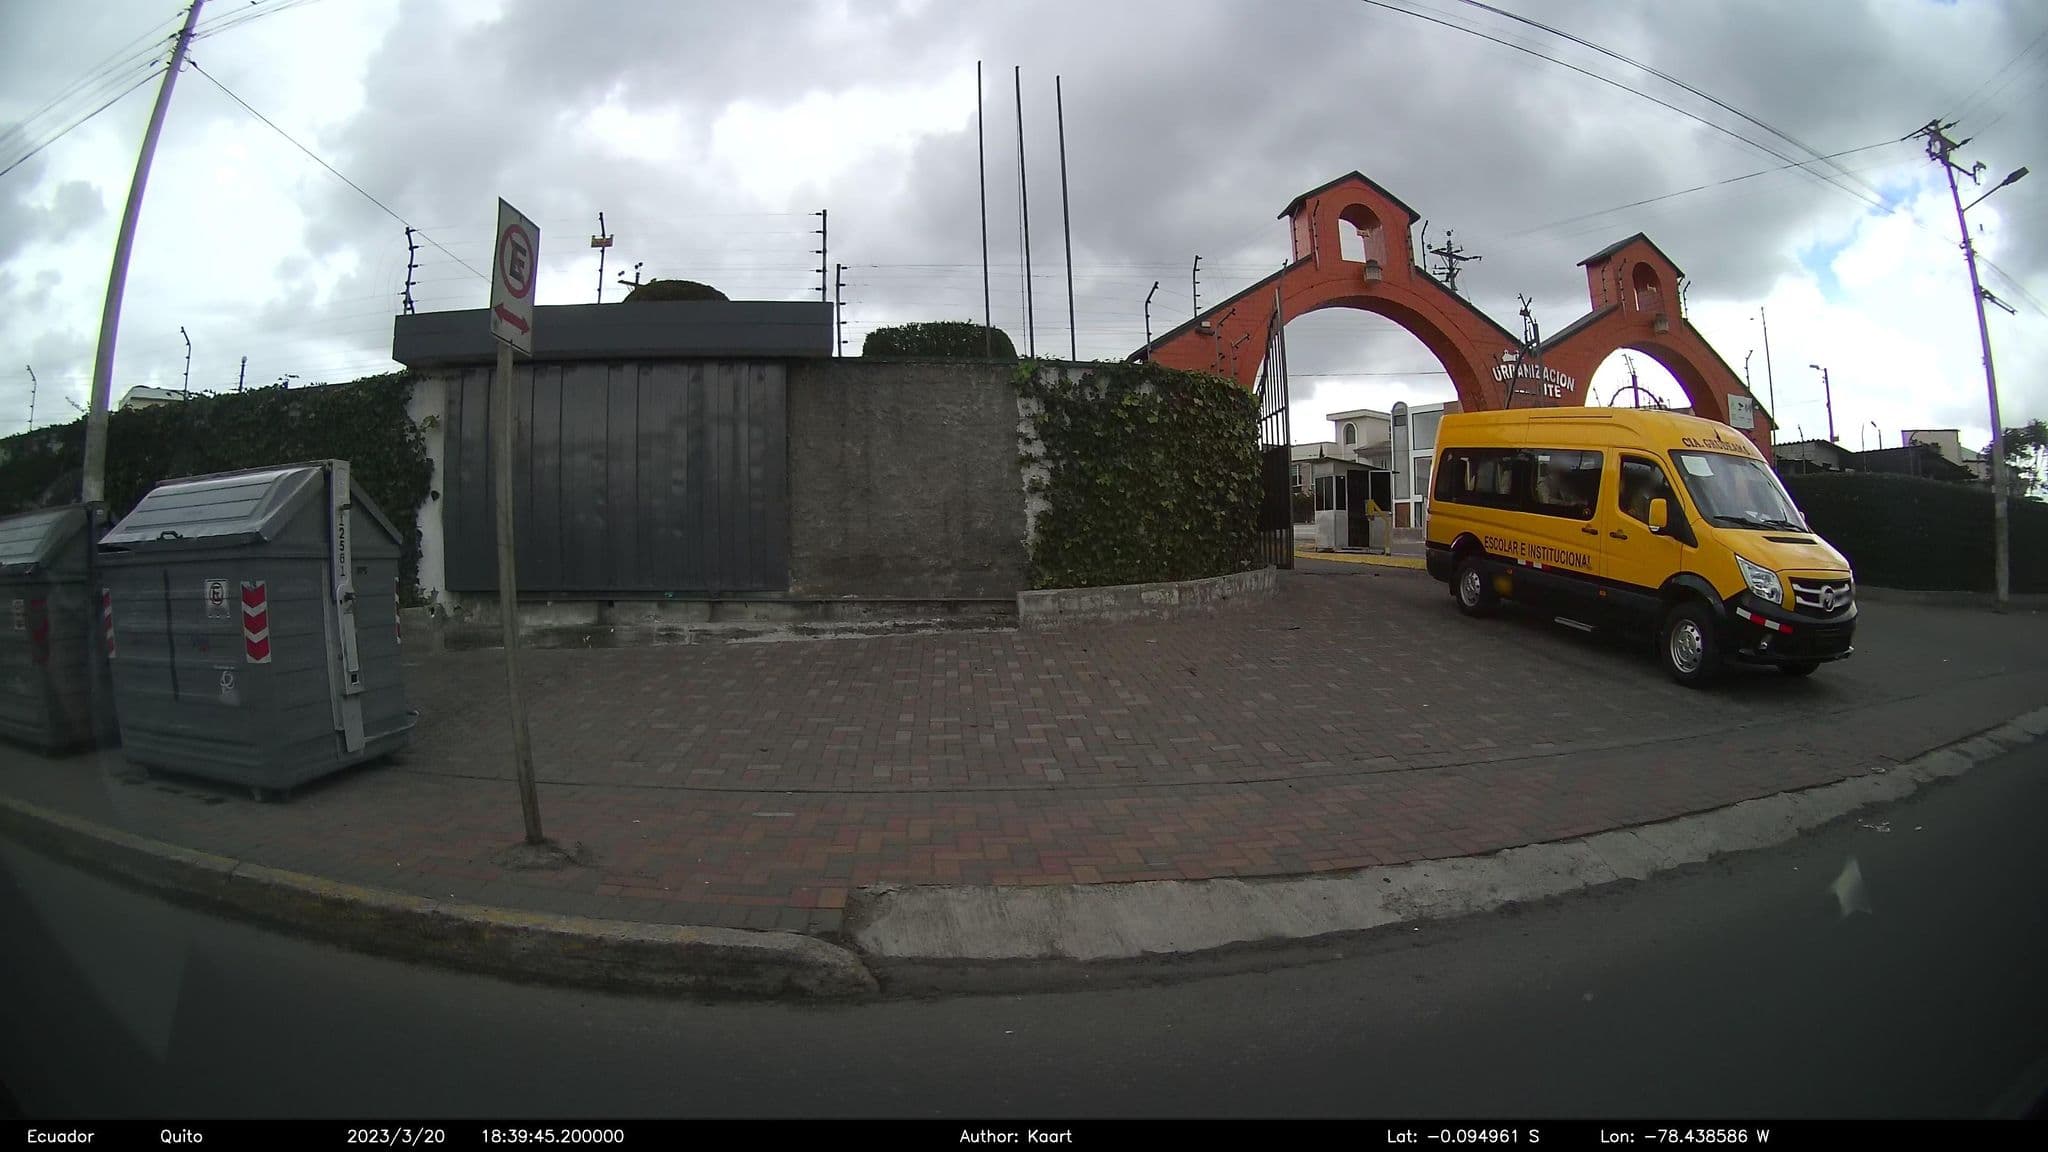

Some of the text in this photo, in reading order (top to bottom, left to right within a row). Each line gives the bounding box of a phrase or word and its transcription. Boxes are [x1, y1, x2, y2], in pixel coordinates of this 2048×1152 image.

[509, 242, 527, 282] E
[1484, 535, 1518, 555] ESCOLAR
[1520, 542, 1526, 556] E
